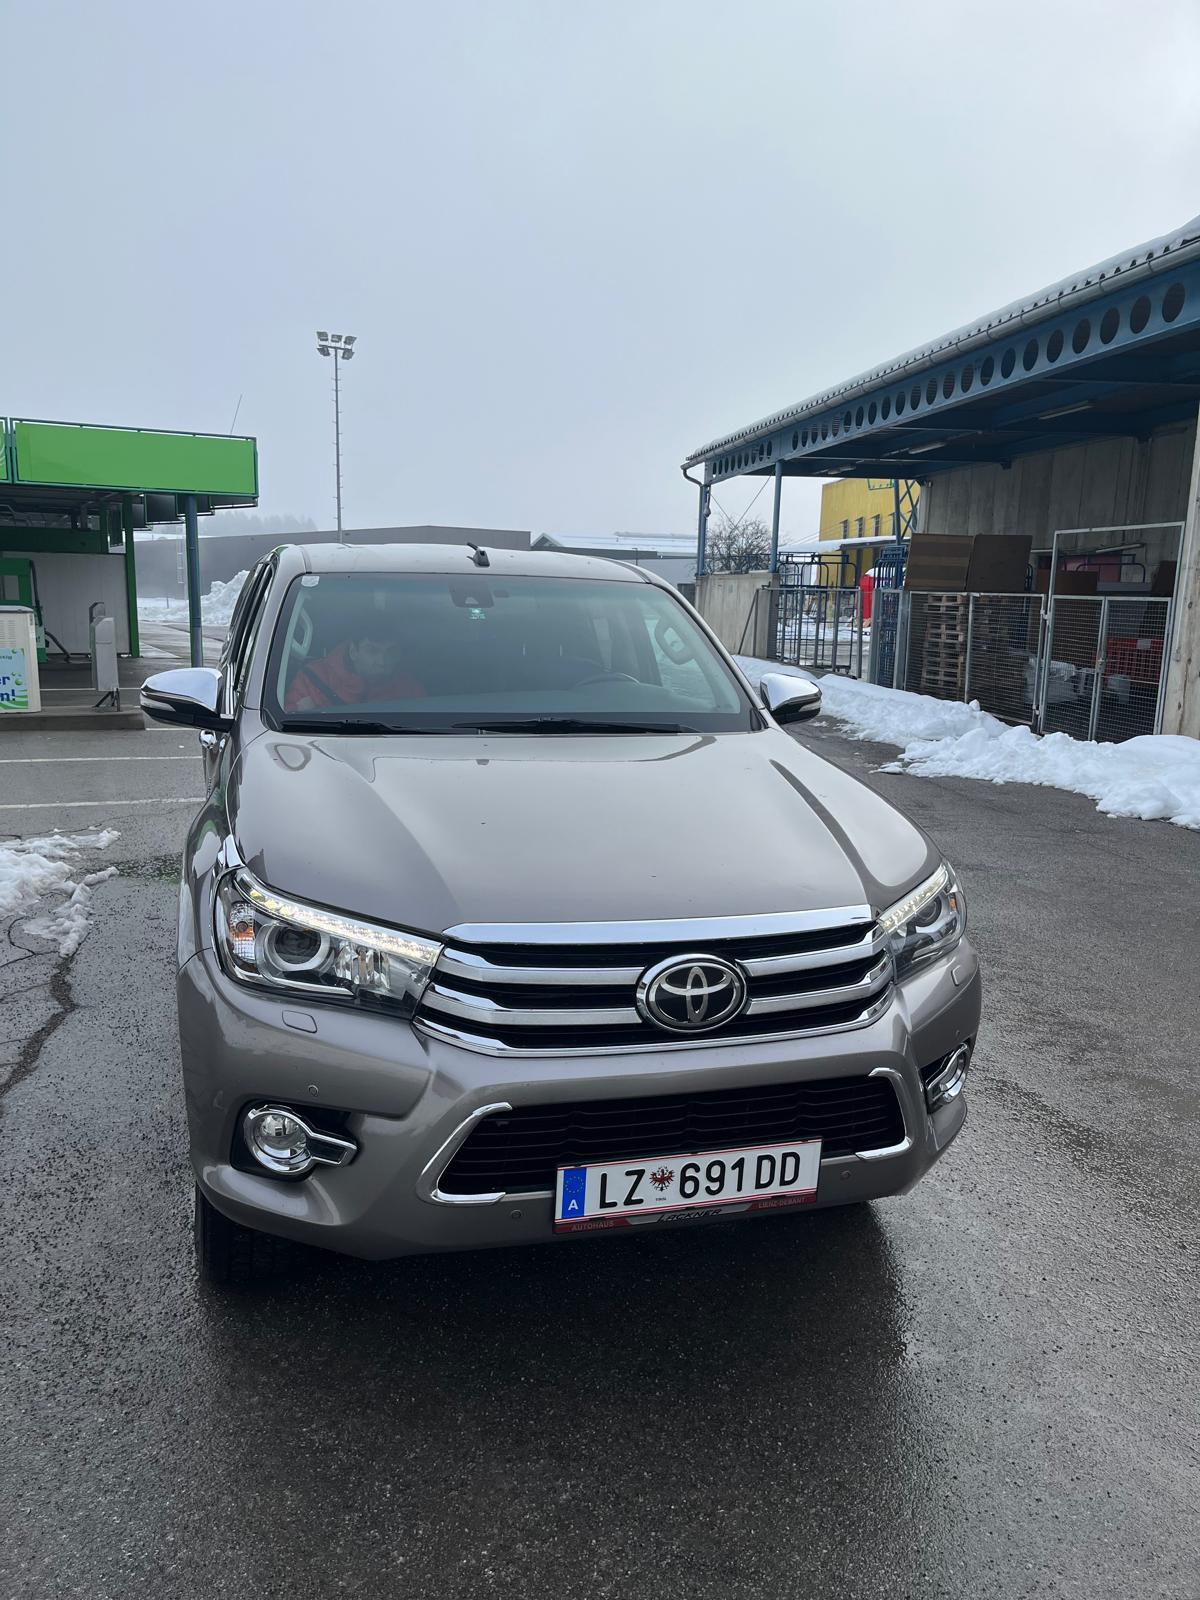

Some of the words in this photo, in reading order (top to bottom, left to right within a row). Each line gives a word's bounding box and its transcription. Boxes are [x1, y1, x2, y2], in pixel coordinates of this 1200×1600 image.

[0, 676, 10, 685] r
[599, 1169, 645, 1209] LZ
[568, 1199, 578, 1210] A
[571, 1221, 615, 1231] AUTOHAUS
